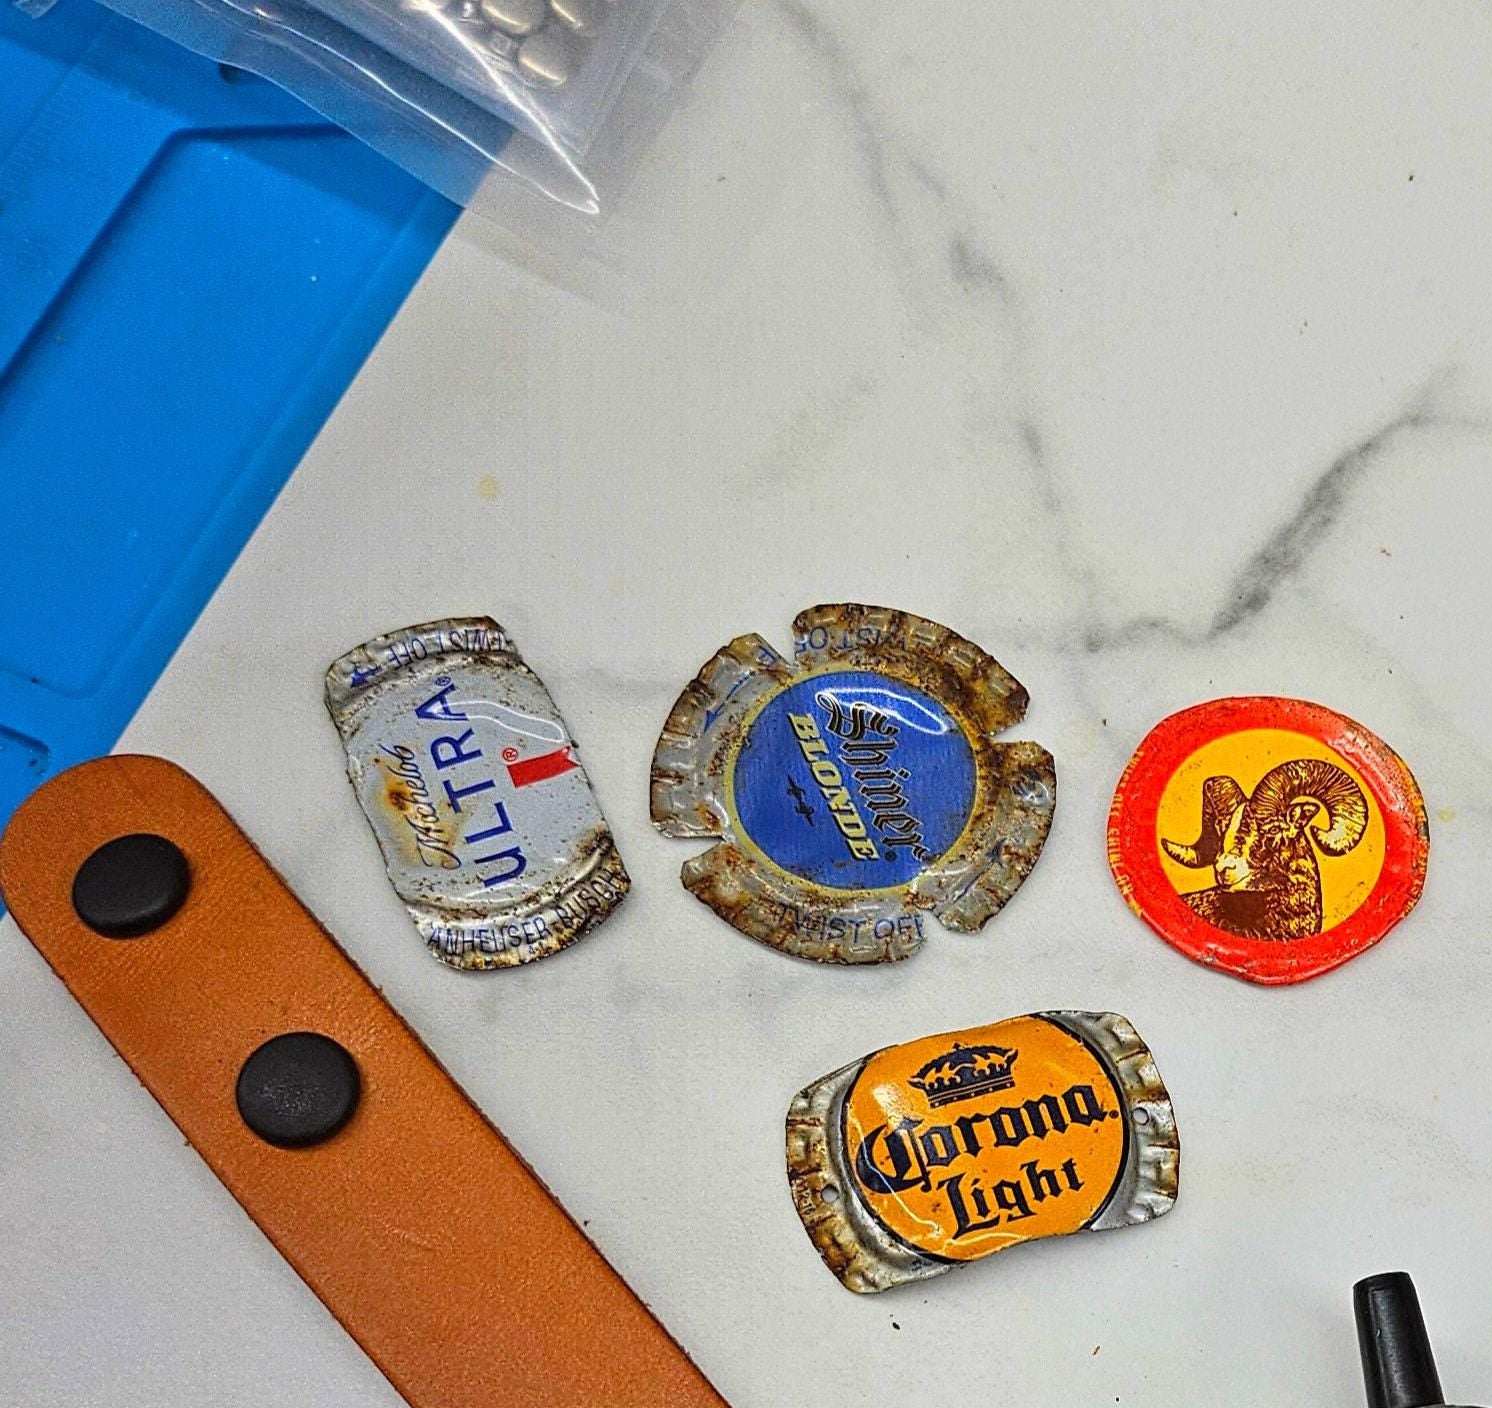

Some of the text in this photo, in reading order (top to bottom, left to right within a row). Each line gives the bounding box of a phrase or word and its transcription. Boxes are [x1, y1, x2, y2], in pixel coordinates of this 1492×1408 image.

[387, 638, 427, 670] OFF
[415, 683, 528, 888] ULTRA
[787, 711, 881, 863] BLONDE
[815, 692, 929, 862] Shiner
[855, 1084, 1108, 1195] Corona
[937, 1156, 1085, 1241] Light
